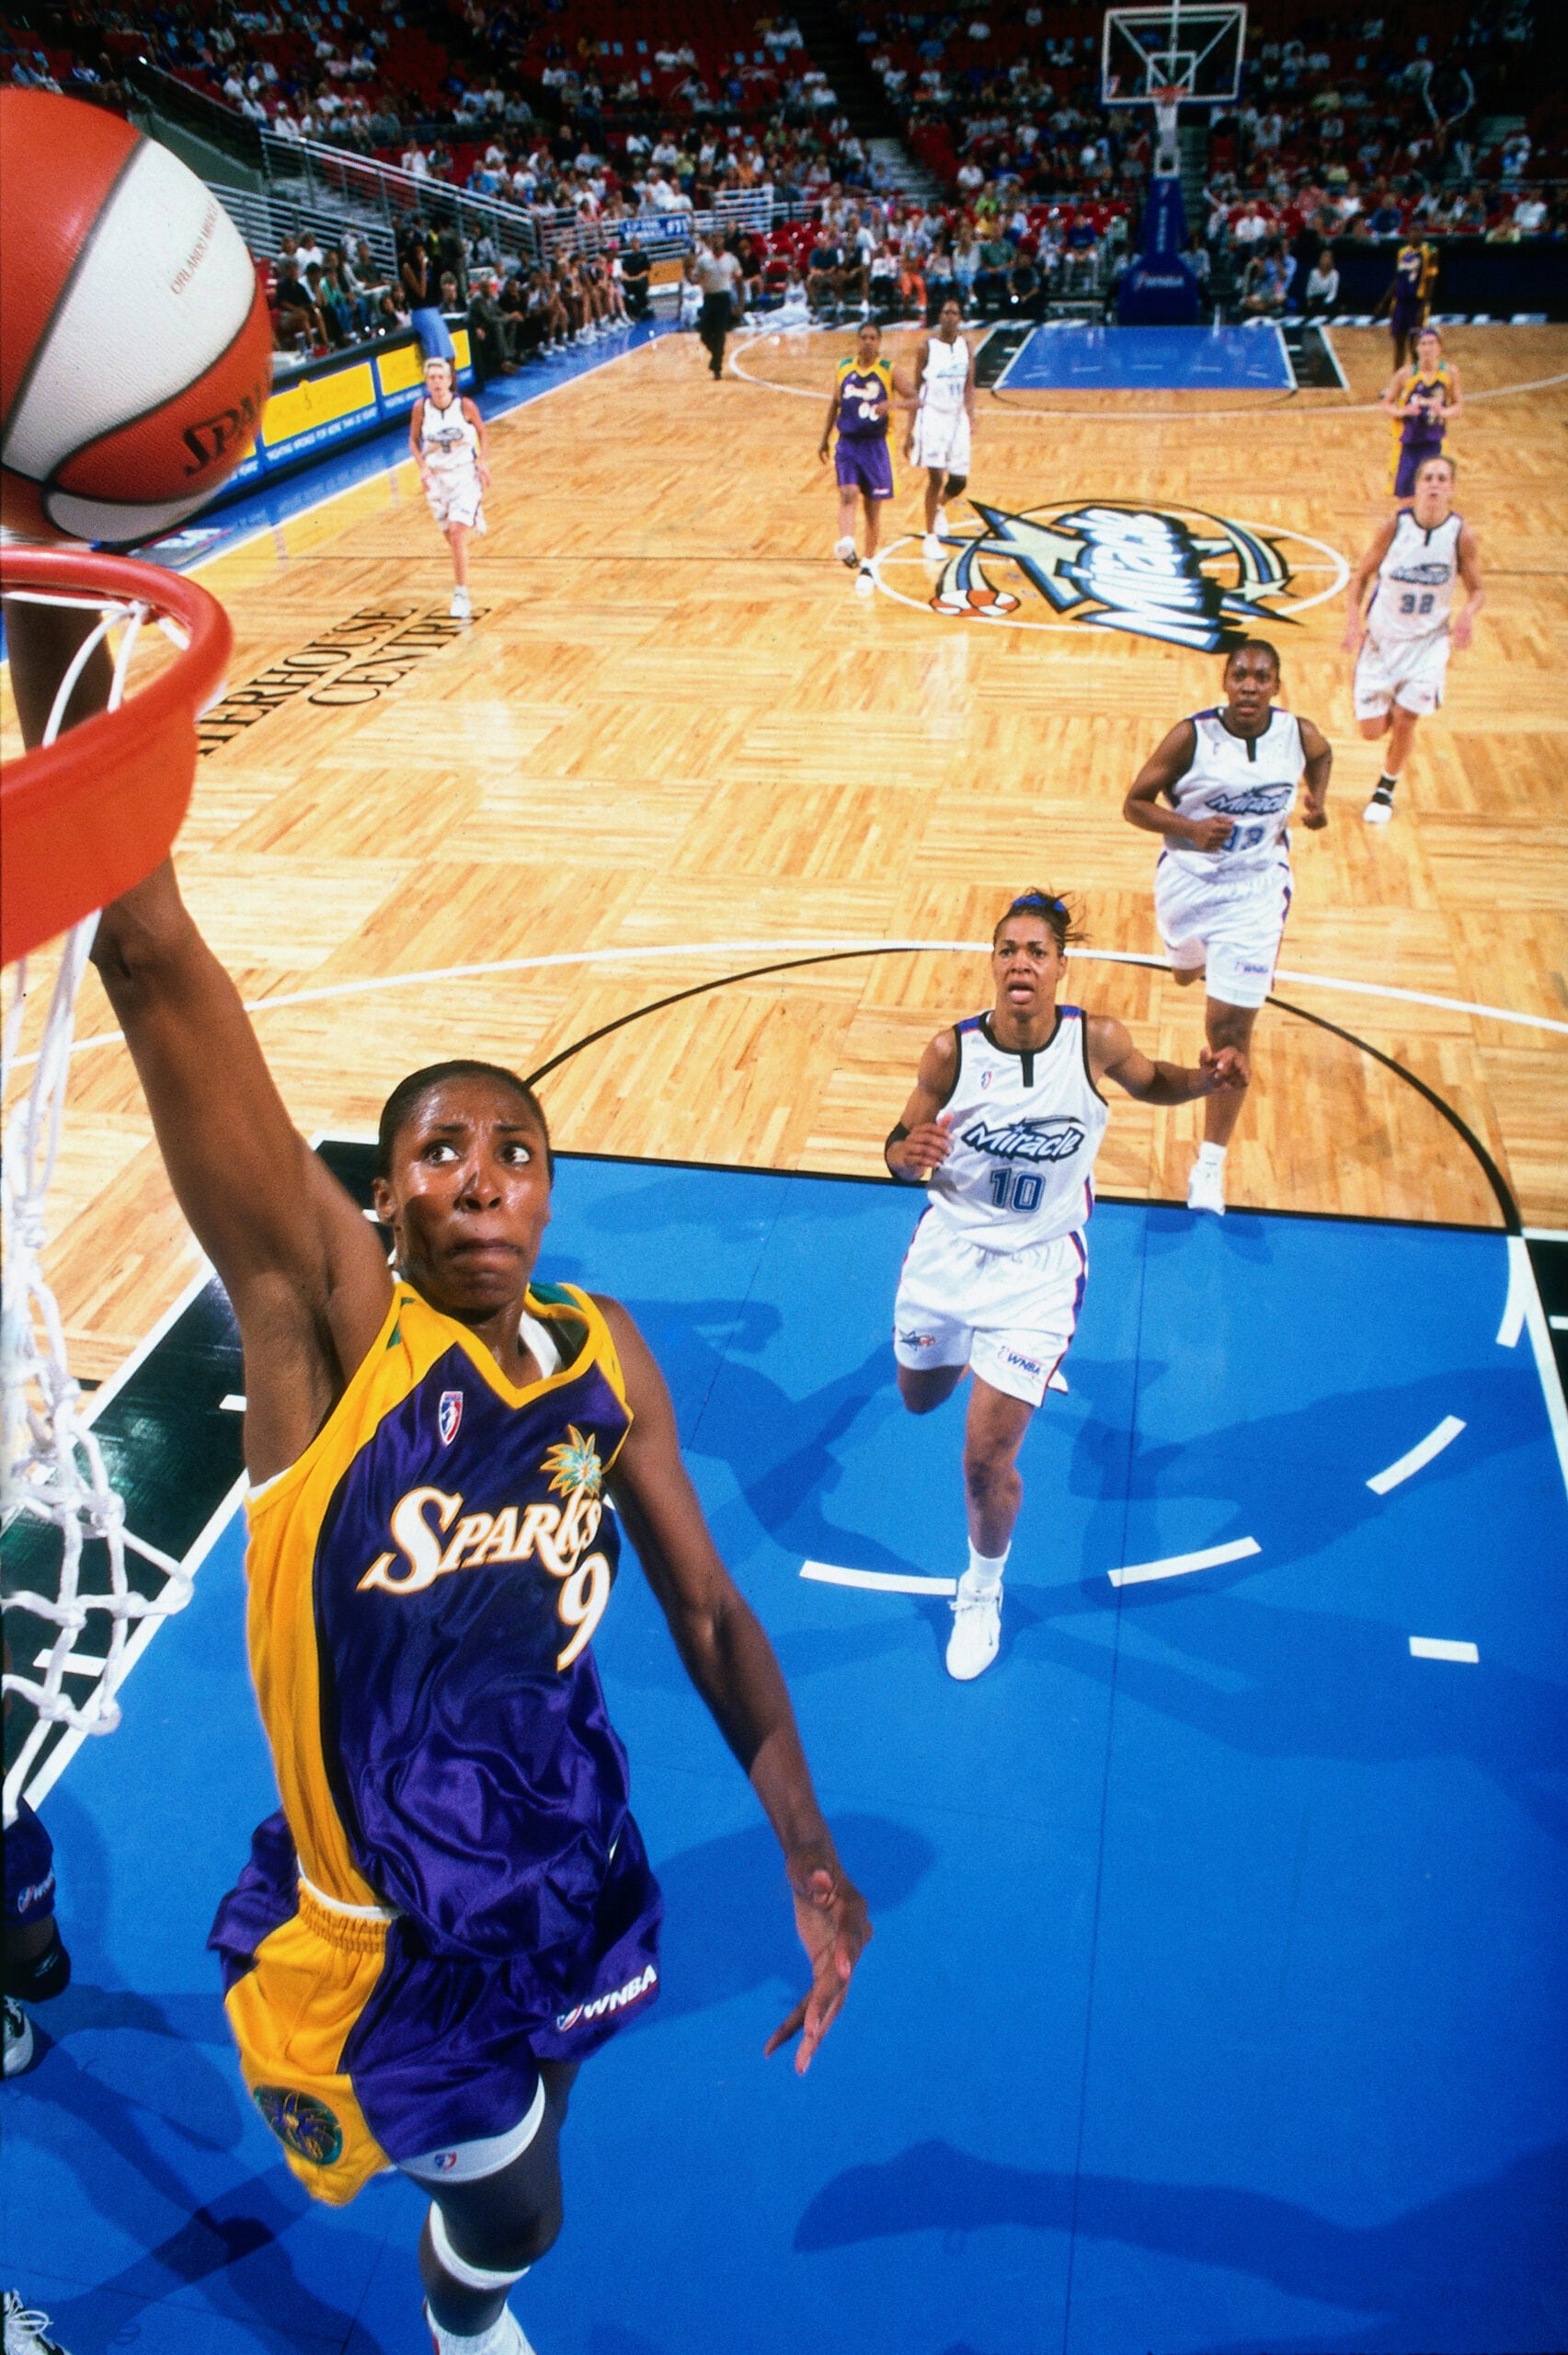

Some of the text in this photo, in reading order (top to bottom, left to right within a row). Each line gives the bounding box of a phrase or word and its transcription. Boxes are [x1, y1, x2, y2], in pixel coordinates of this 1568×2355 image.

[961, 1120, 1086, 1163] Miracle
[989, 1166, 1046, 1212] 10
[1007, 1351, 1041, 1376] WNBA
[355, 1486, 602, 1595] SPARKS
[556, 1552, 611, 1673] 9
[583, 1964, 658, 2019] WNBA
